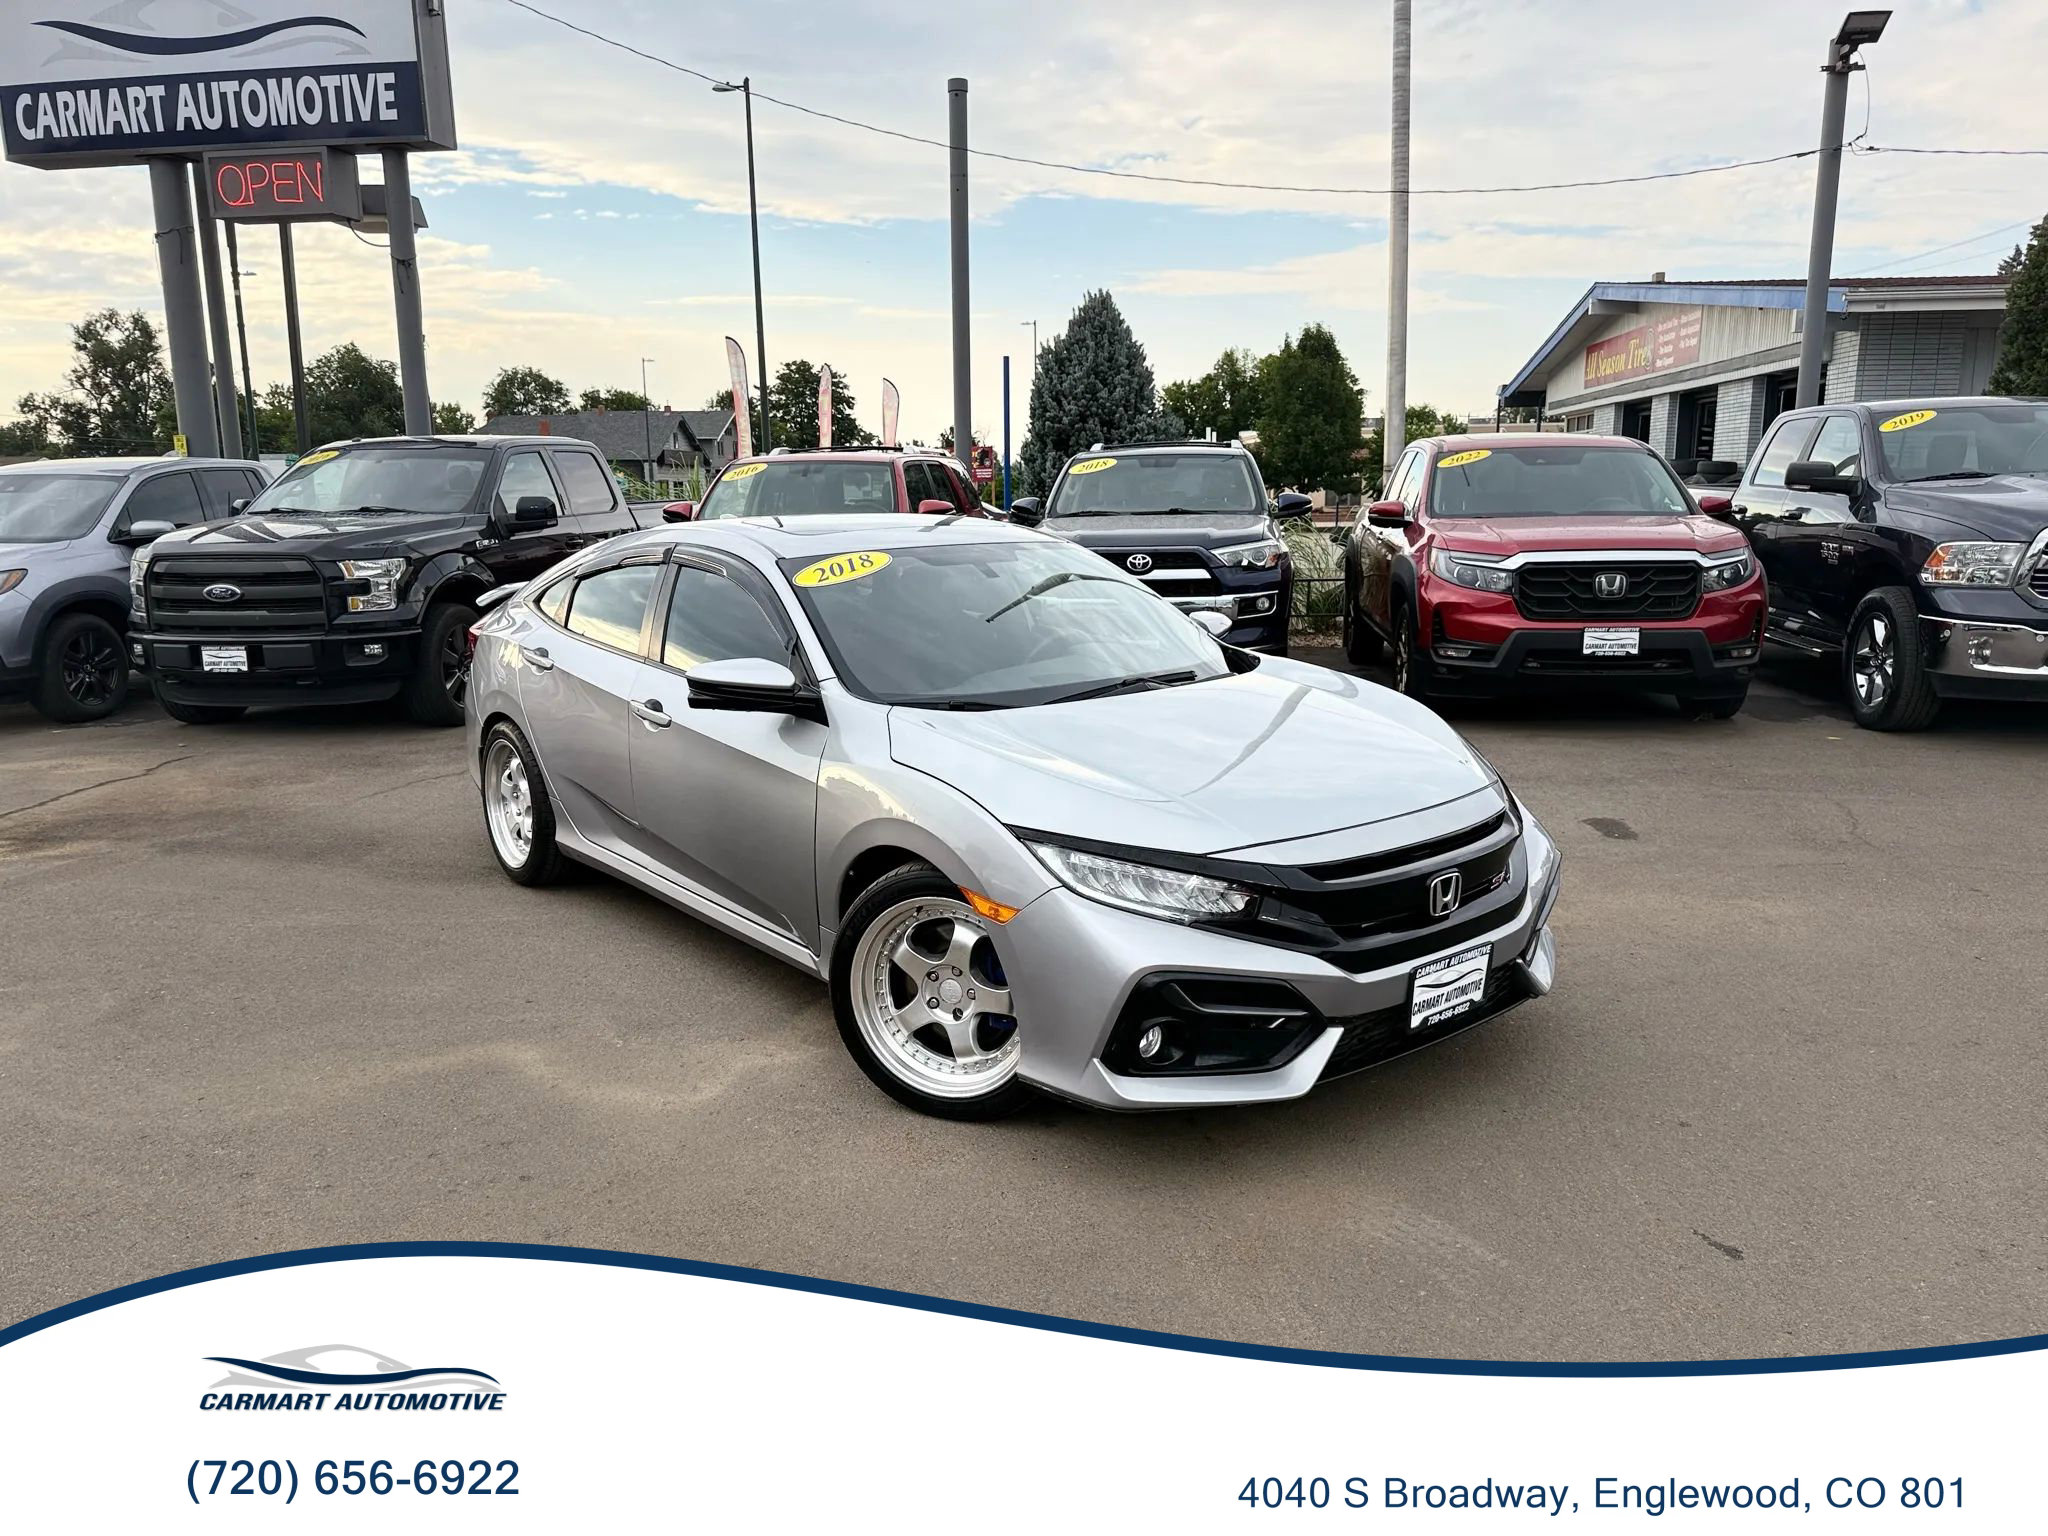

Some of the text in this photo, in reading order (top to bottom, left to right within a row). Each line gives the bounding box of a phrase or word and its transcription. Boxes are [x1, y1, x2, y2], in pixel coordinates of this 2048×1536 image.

[15, 72, 399, 141] CARMART AUTOMOTIVE
[217, 161, 324, 206] OPEN
[1586, 351, 1598, 379] All
[1597, 350, 1626, 377] Season
[1890, 412, 1925, 429] 2019
[1448, 451, 1481, 465] 2022
[813, 554, 875, 583] 2018
[1415, 943, 1493, 978] CARMART AUTOMOTIVE
[1412, 977, 1484, 1016] CARMART AUTOMOTIVE
